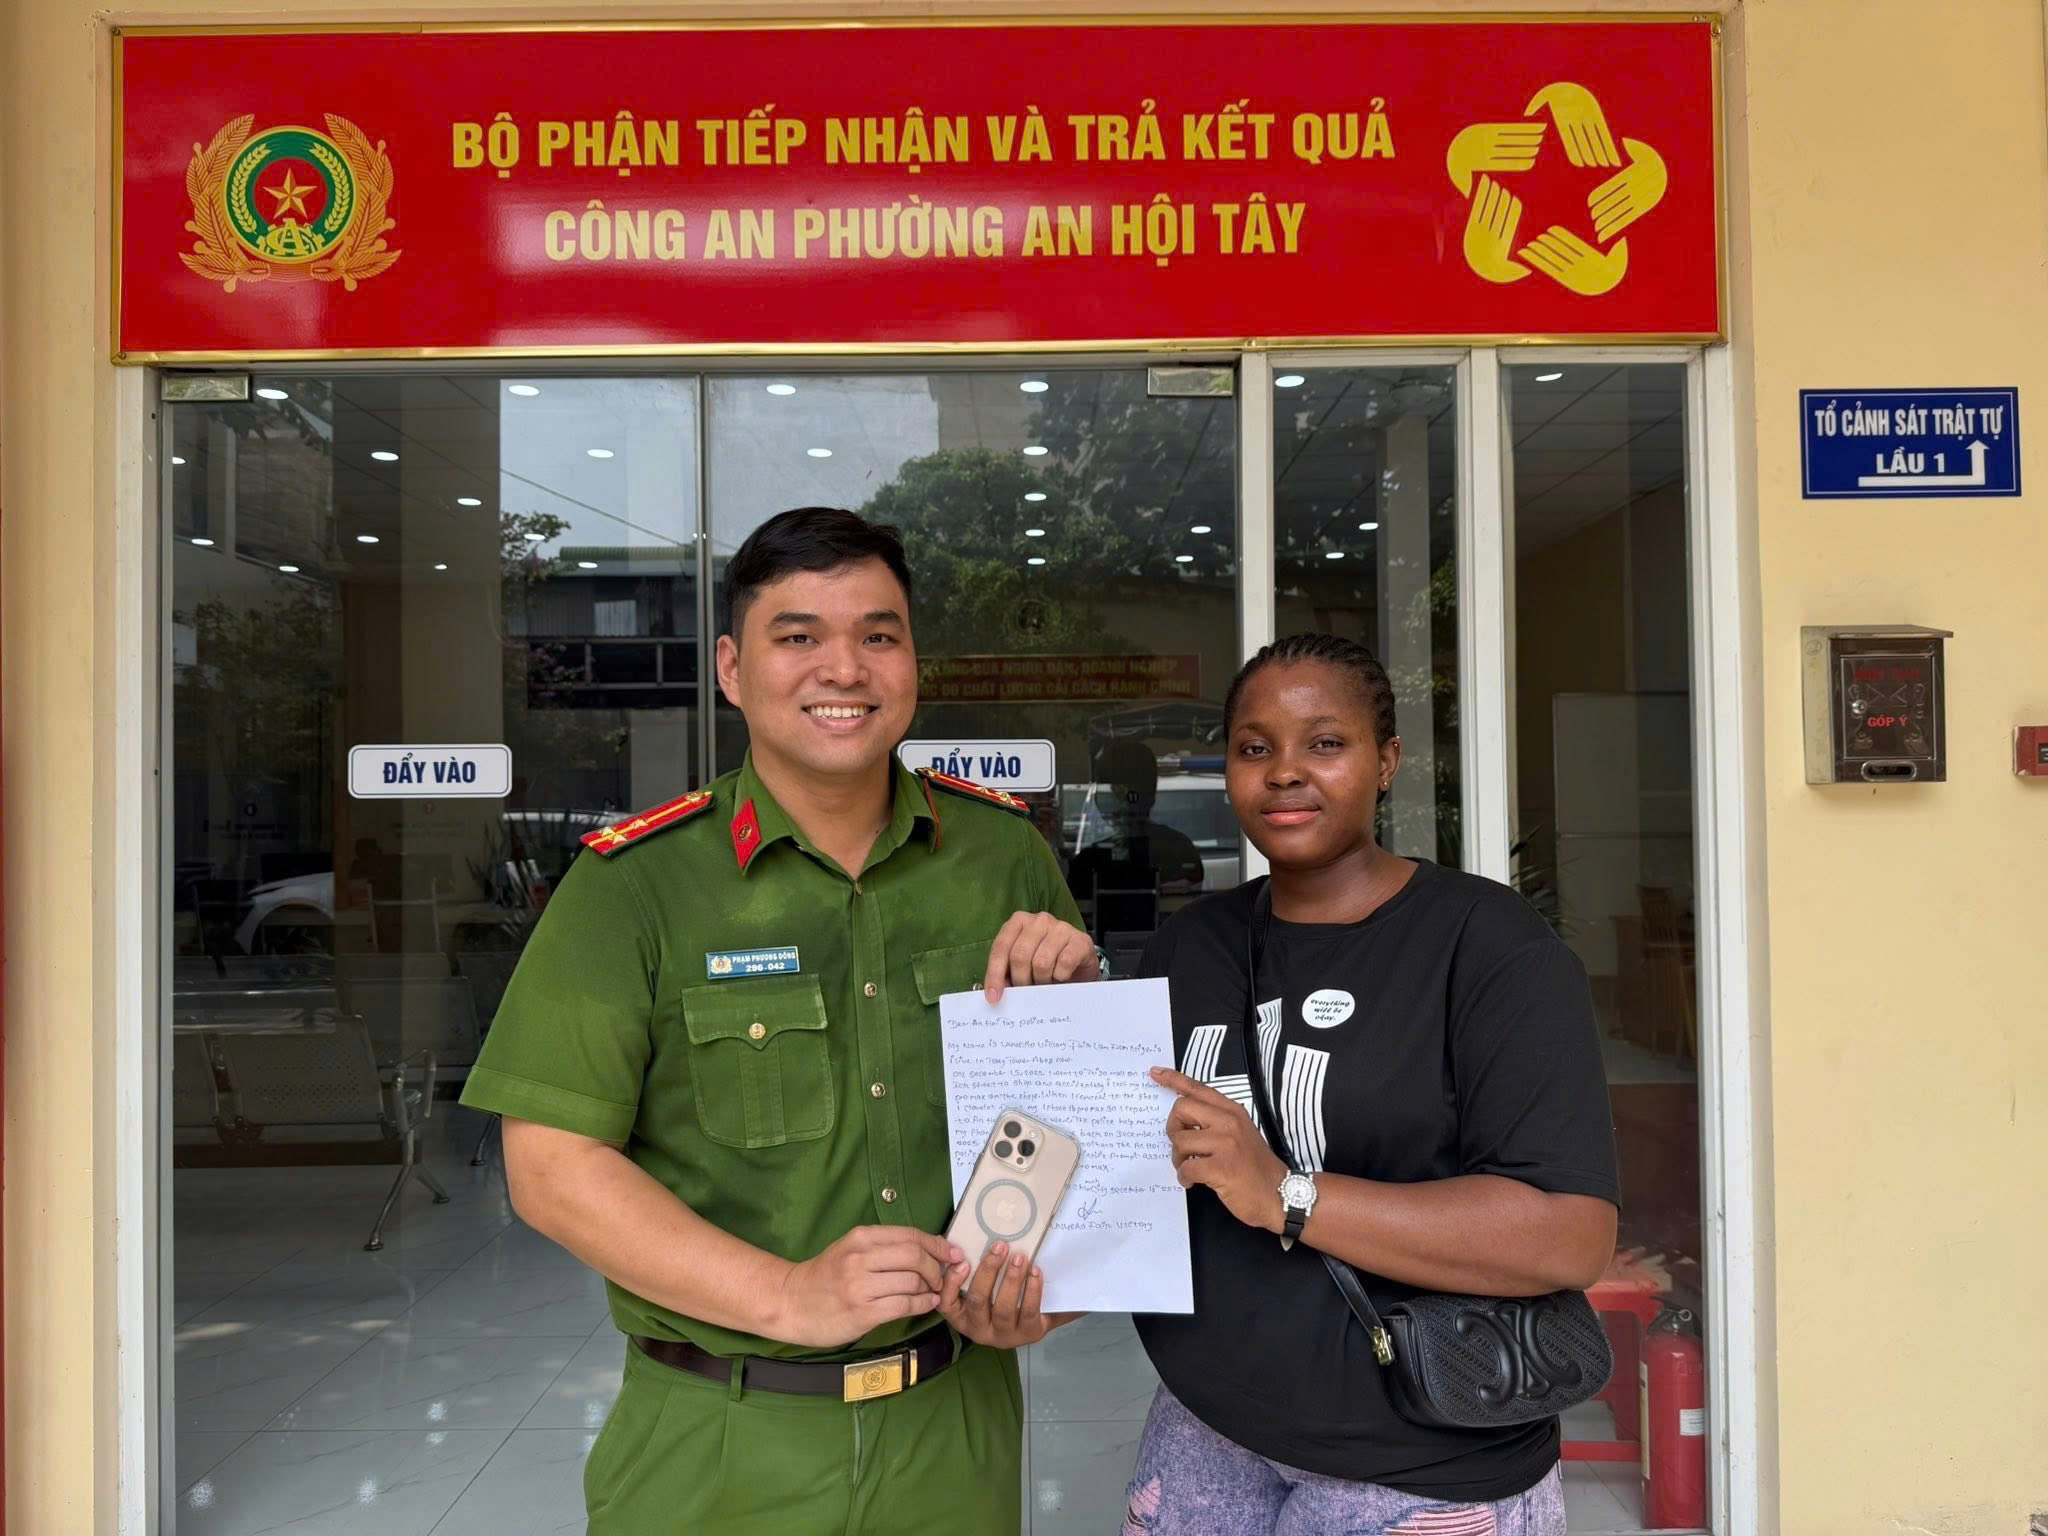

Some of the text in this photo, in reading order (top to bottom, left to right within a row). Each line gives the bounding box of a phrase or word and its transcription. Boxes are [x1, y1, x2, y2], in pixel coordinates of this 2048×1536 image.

[452, 97, 1396, 178] BỘ PHẬN TIẾP NHẬN VÀ TRẢ KẾT QUẢ
[545, 192, 1306, 267] CÔNG AN PHƯỜNG AN HỘI TÂY
[1814, 400, 2004, 440] TỔ CẢNH SÁT TRẬT TỰ
[1875, 446, 1945, 474] LẦU 1
[1867, 713, 1909, 728] GÓP Ý
[382, 752, 476, 784] ĐẨY VÀO
[931, 747, 1021, 778] ĐẨY VÀO
[1310, 999, 1350, 1008] everything
